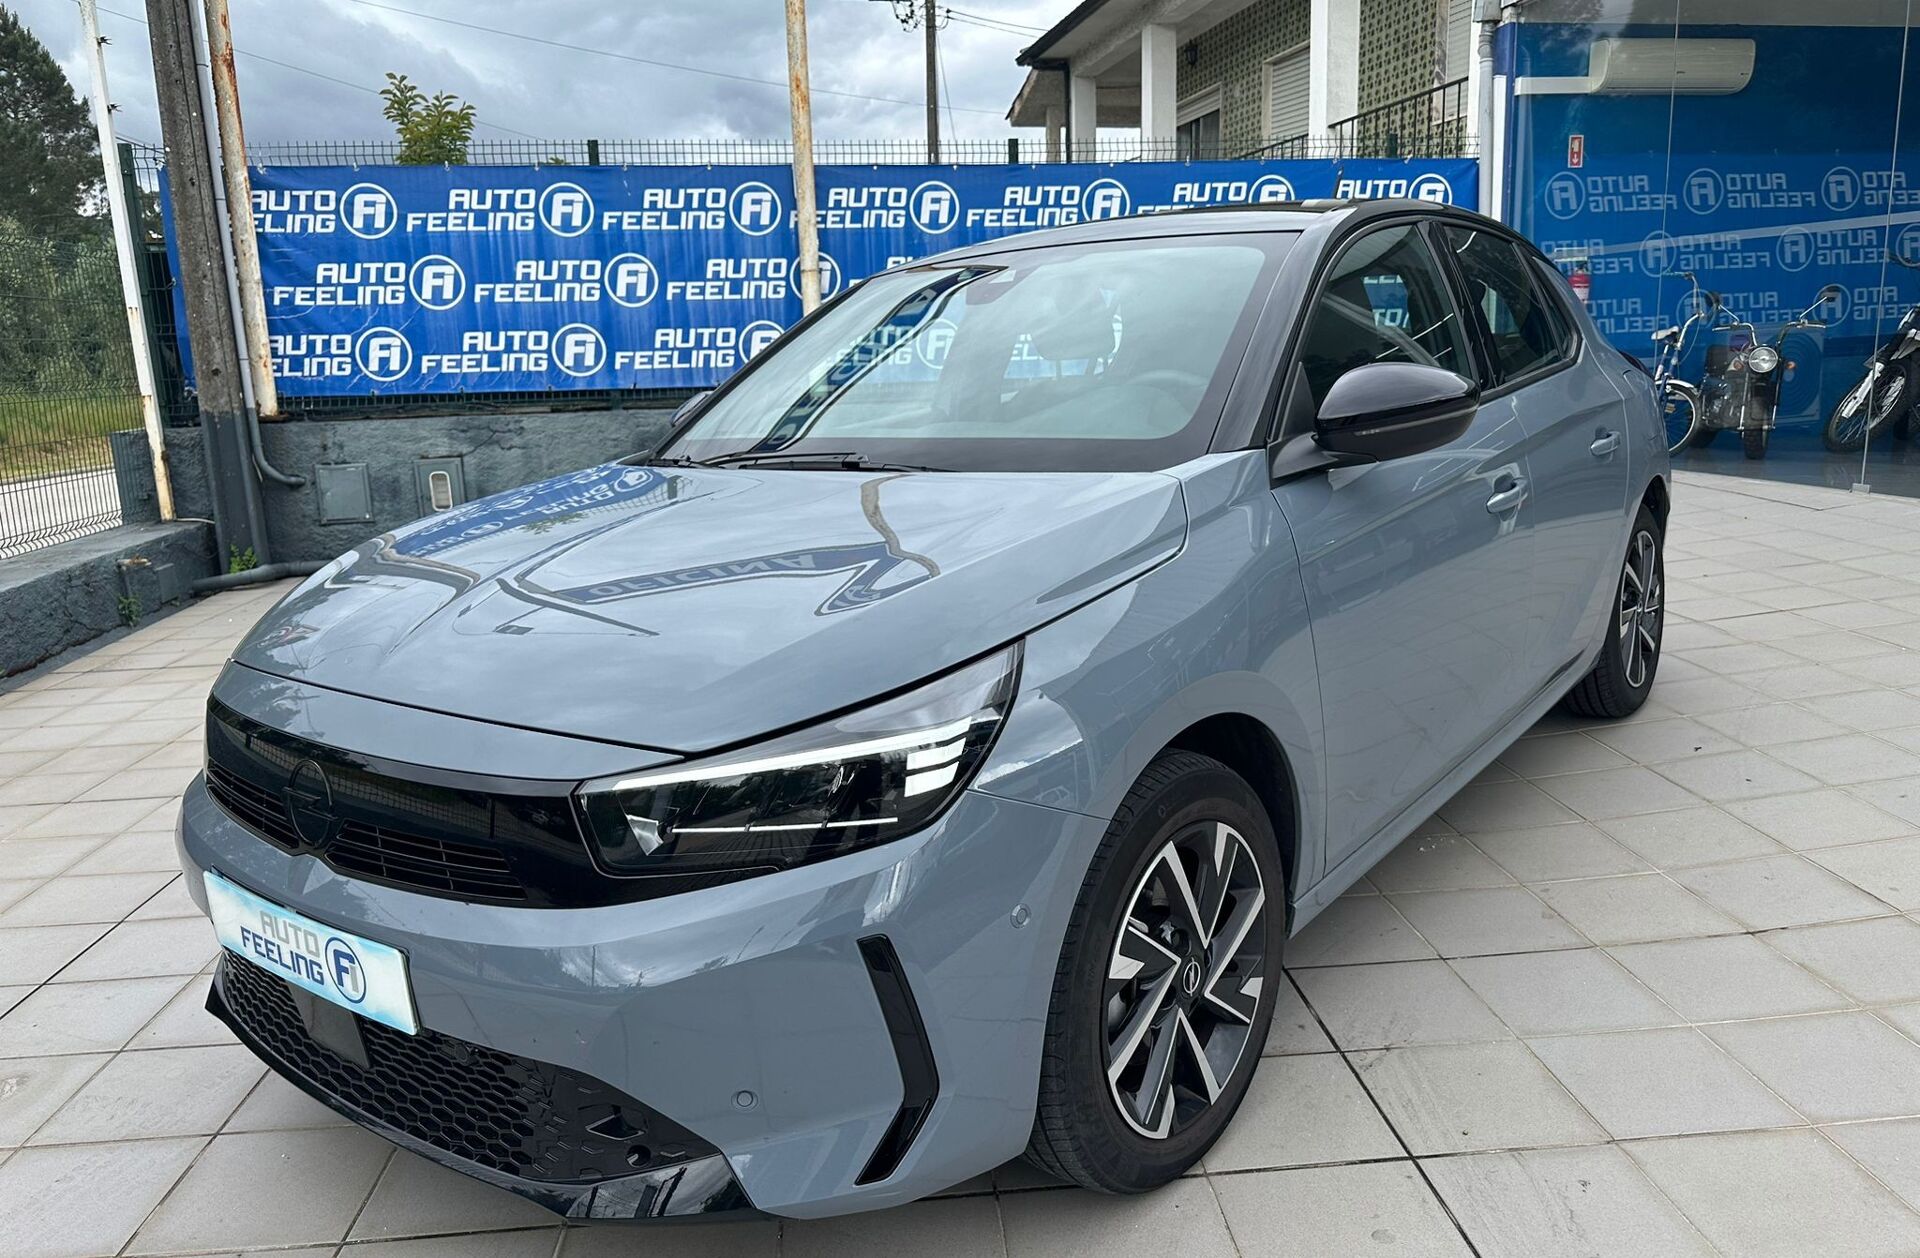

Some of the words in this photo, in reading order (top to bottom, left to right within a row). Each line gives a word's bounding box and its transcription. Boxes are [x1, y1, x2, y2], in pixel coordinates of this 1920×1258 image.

[449, 189, 535, 209] AUTO
[644, 189, 726, 208] AUTO
[829, 188, 907, 207] AUTO
[1004, 186, 1080, 205] AUTO
[1173, 182, 1248, 203] AUTO
[1337, 179, 1407, 199] AUTO
[251, 190, 336, 211] AUTO
[254, 214, 336, 233] ELING
[407, 212, 534, 231] FEELING
[603, 211, 725, 230] FEELING
[967, 208, 1079, 227] FEELING
[317, 263, 405, 283] AUTO
[516, 260, 601, 280] AUTO
[707, 259, 787, 278] AUTO
[274, 286, 405, 305] FEELING
[475, 283, 600, 302] FEELING
[667, 281, 785, 300] FEELING
[270, 335, 351, 355] AUTO
[463, 331, 548, 351] AUTO
[655, 328, 736, 348] AUTO
[273, 357, 351, 377] ELING
[422, 353, 547, 373] FEELING
[615, 350, 735, 369] FEELING
[260, 910, 320, 958] AUTO
[240, 926, 325, 986] FEELING
